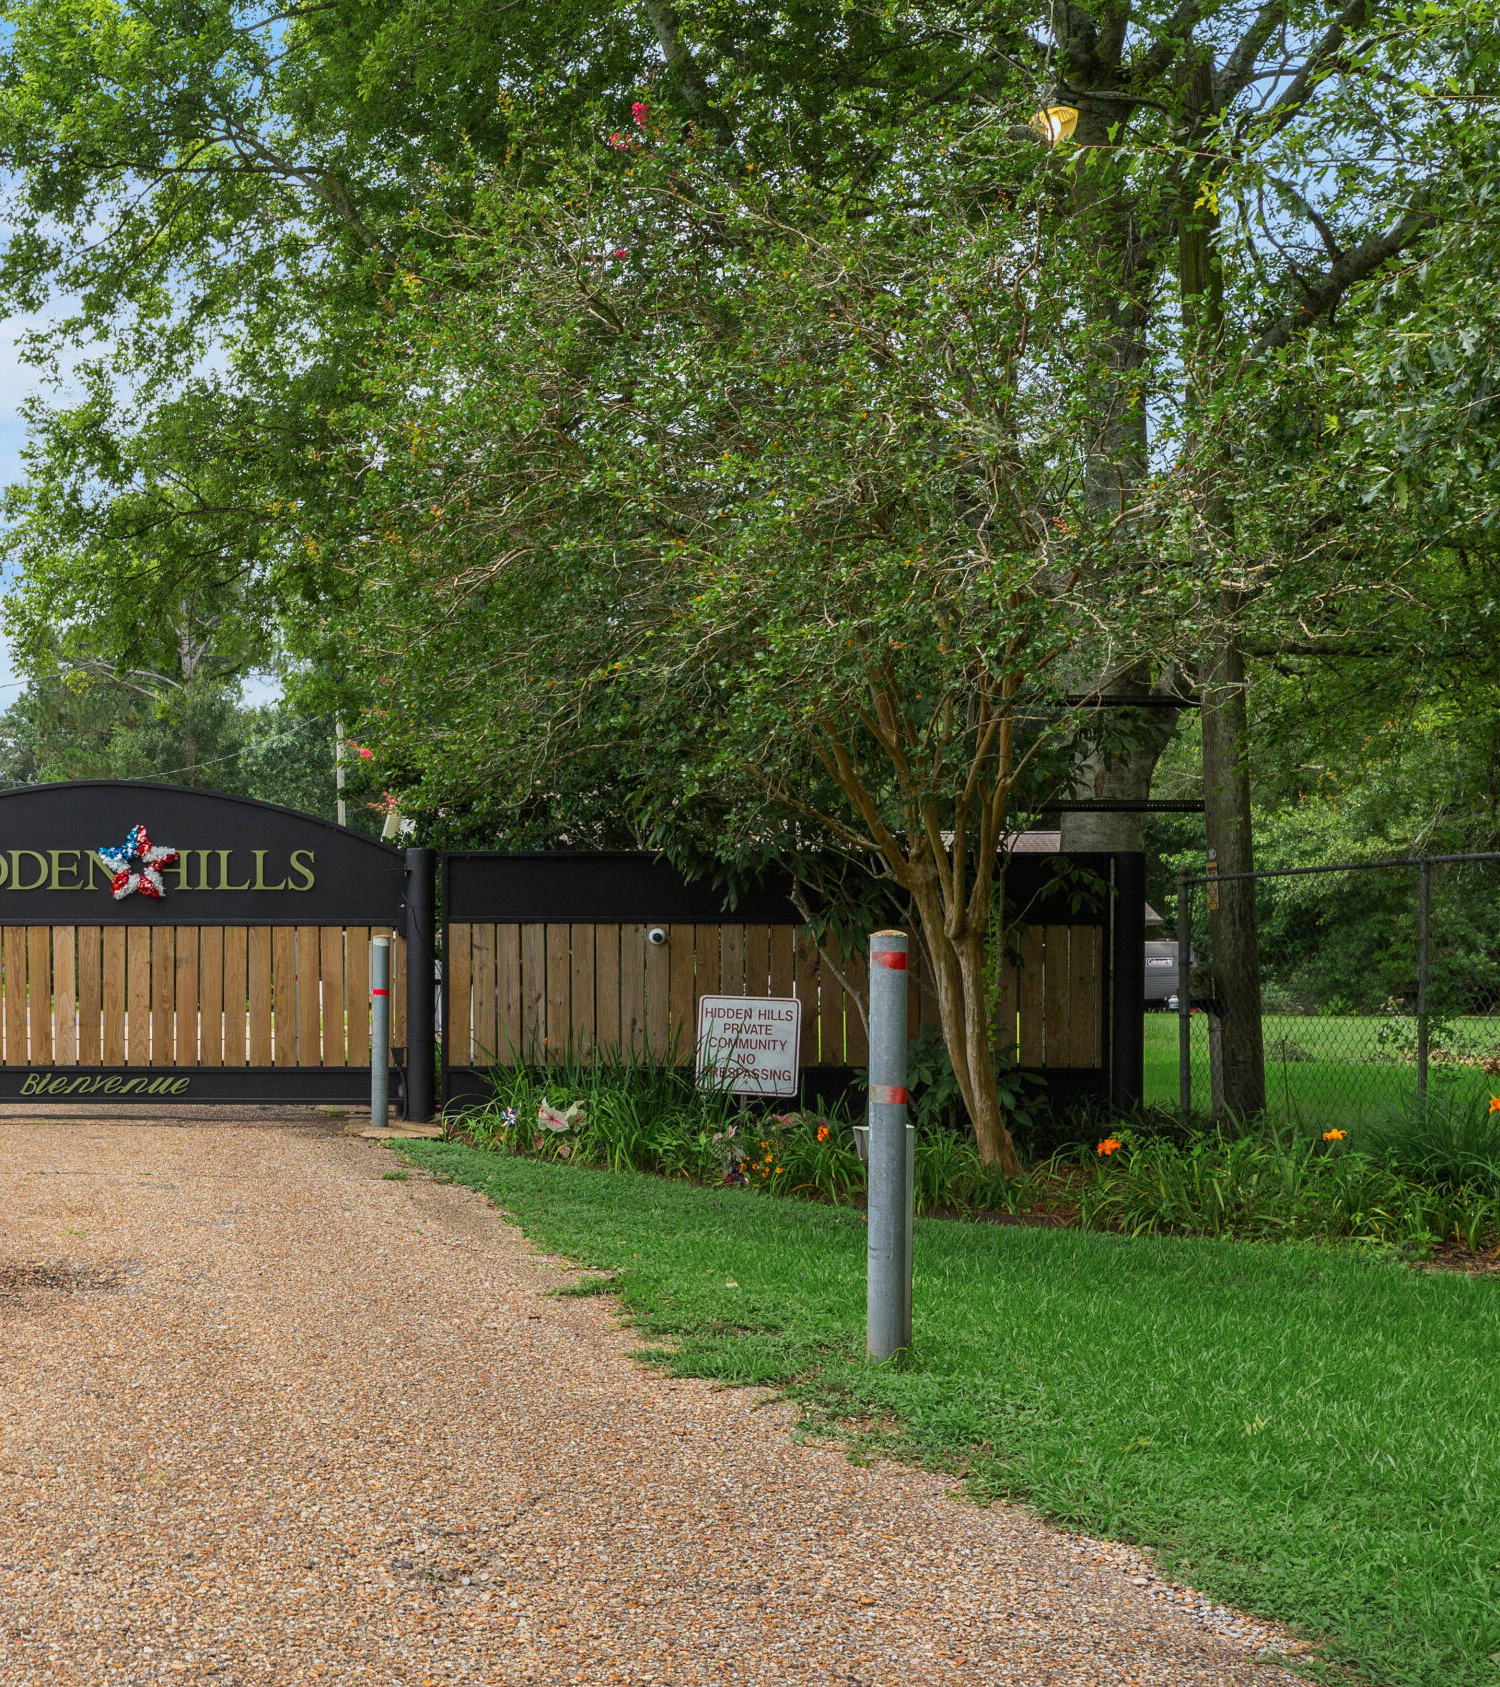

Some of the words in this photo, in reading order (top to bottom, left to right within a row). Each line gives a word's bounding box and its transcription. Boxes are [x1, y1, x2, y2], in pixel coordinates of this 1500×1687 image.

[705, 1007, 753, 1020] HIDDEN
[758, 1009, 794, 1022] HILLS
[723, 1023, 773, 1036] PRIVATE
[709, 1036, 788, 1052] COMMUNITY
[736, 1053, 756, 1065] NO
[706, 1066, 792, 1082] RESPASSING
[19, 1072, 191, 1096] Bienvenue
